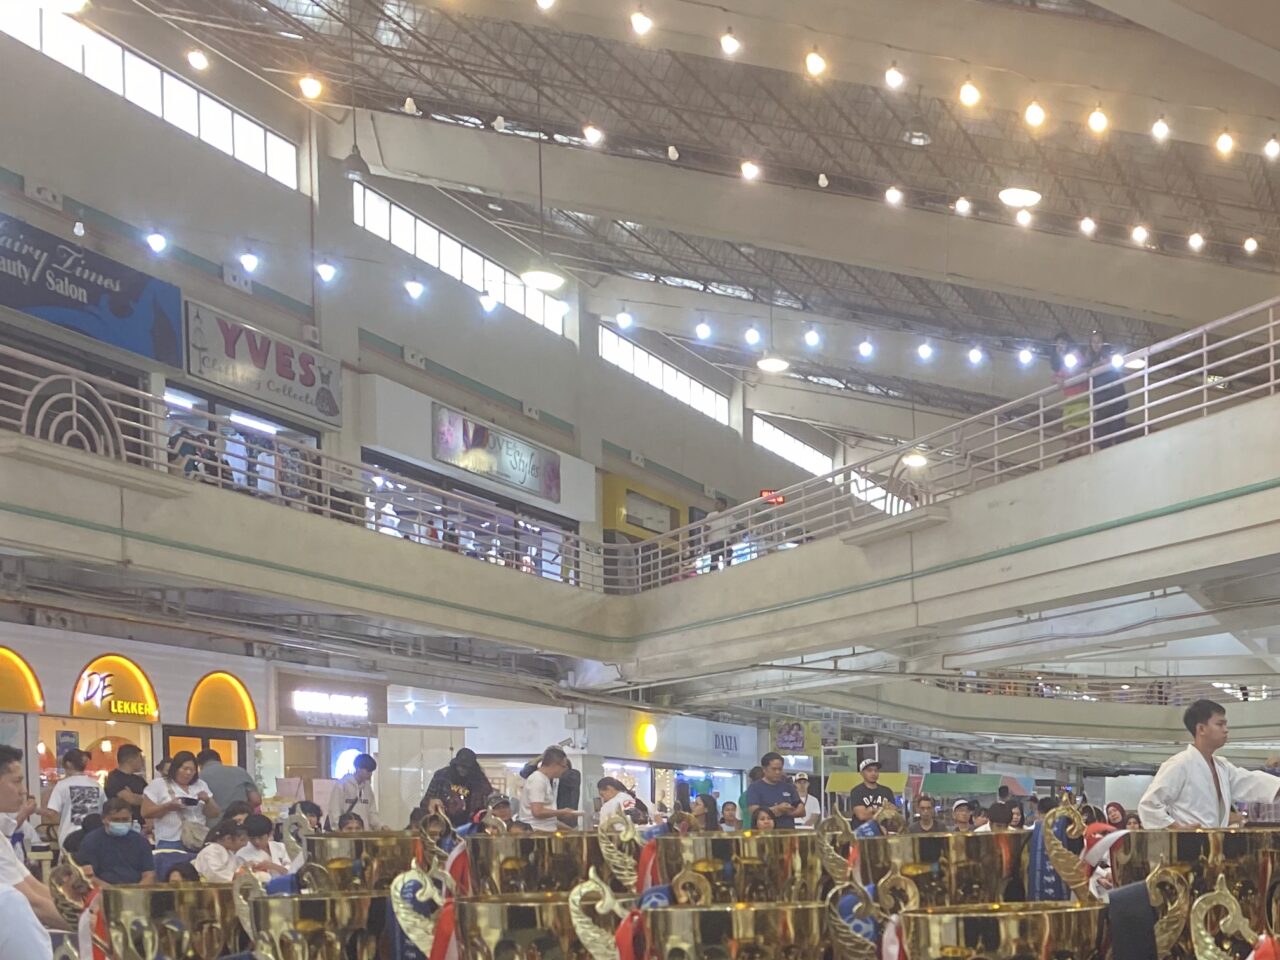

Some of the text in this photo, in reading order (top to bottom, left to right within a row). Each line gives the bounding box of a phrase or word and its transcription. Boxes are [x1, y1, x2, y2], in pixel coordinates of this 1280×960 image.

[46, 269, 87, 304] Salon
[52, 244, 120, 292] Times
[216, 316, 316, 388] YVES
